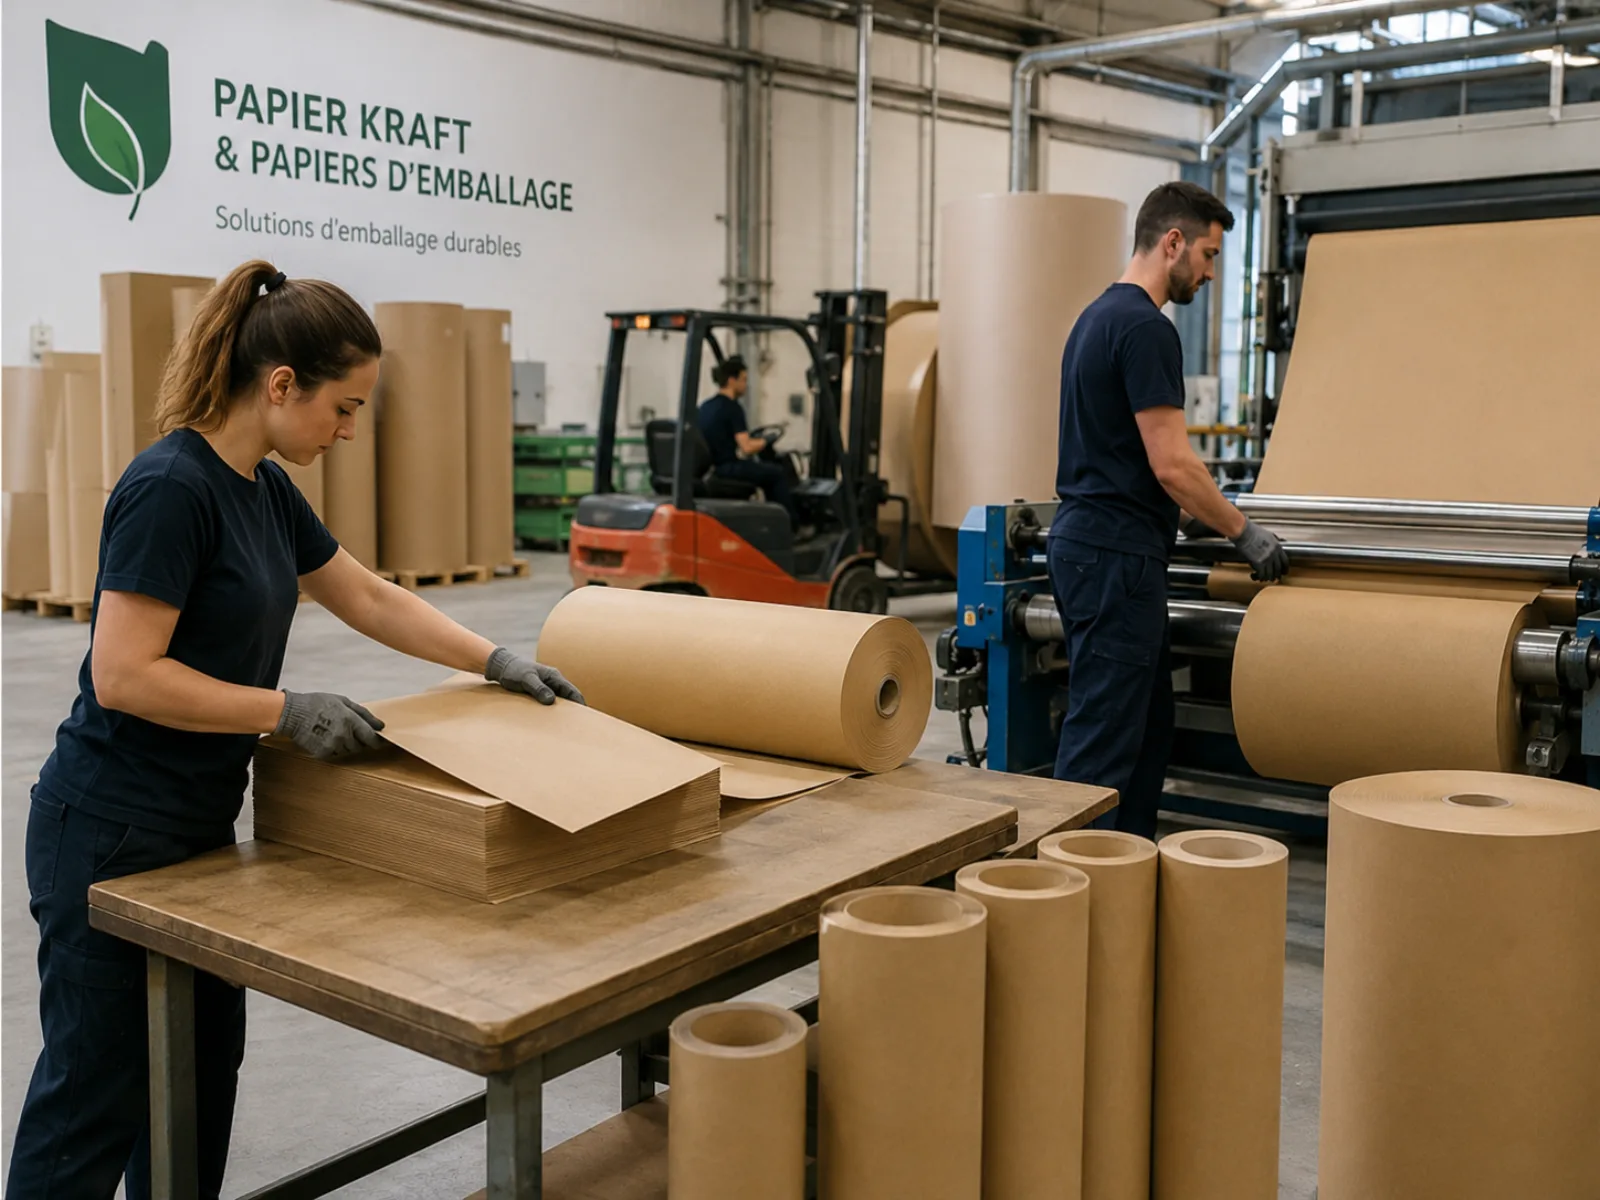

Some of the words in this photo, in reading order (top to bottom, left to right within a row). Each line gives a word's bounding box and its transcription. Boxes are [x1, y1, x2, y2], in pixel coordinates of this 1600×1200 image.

[214, 77, 349, 137] PAPIER
[360, 102, 473, 155] KRAFT
[214, 135, 240, 173] &
[251, 139, 378, 190] PAPIERS
[215, 204, 315, 239] Solutions
[320, 217, 439, 256] d'emballage
[443, 230, 522, 259] durables
